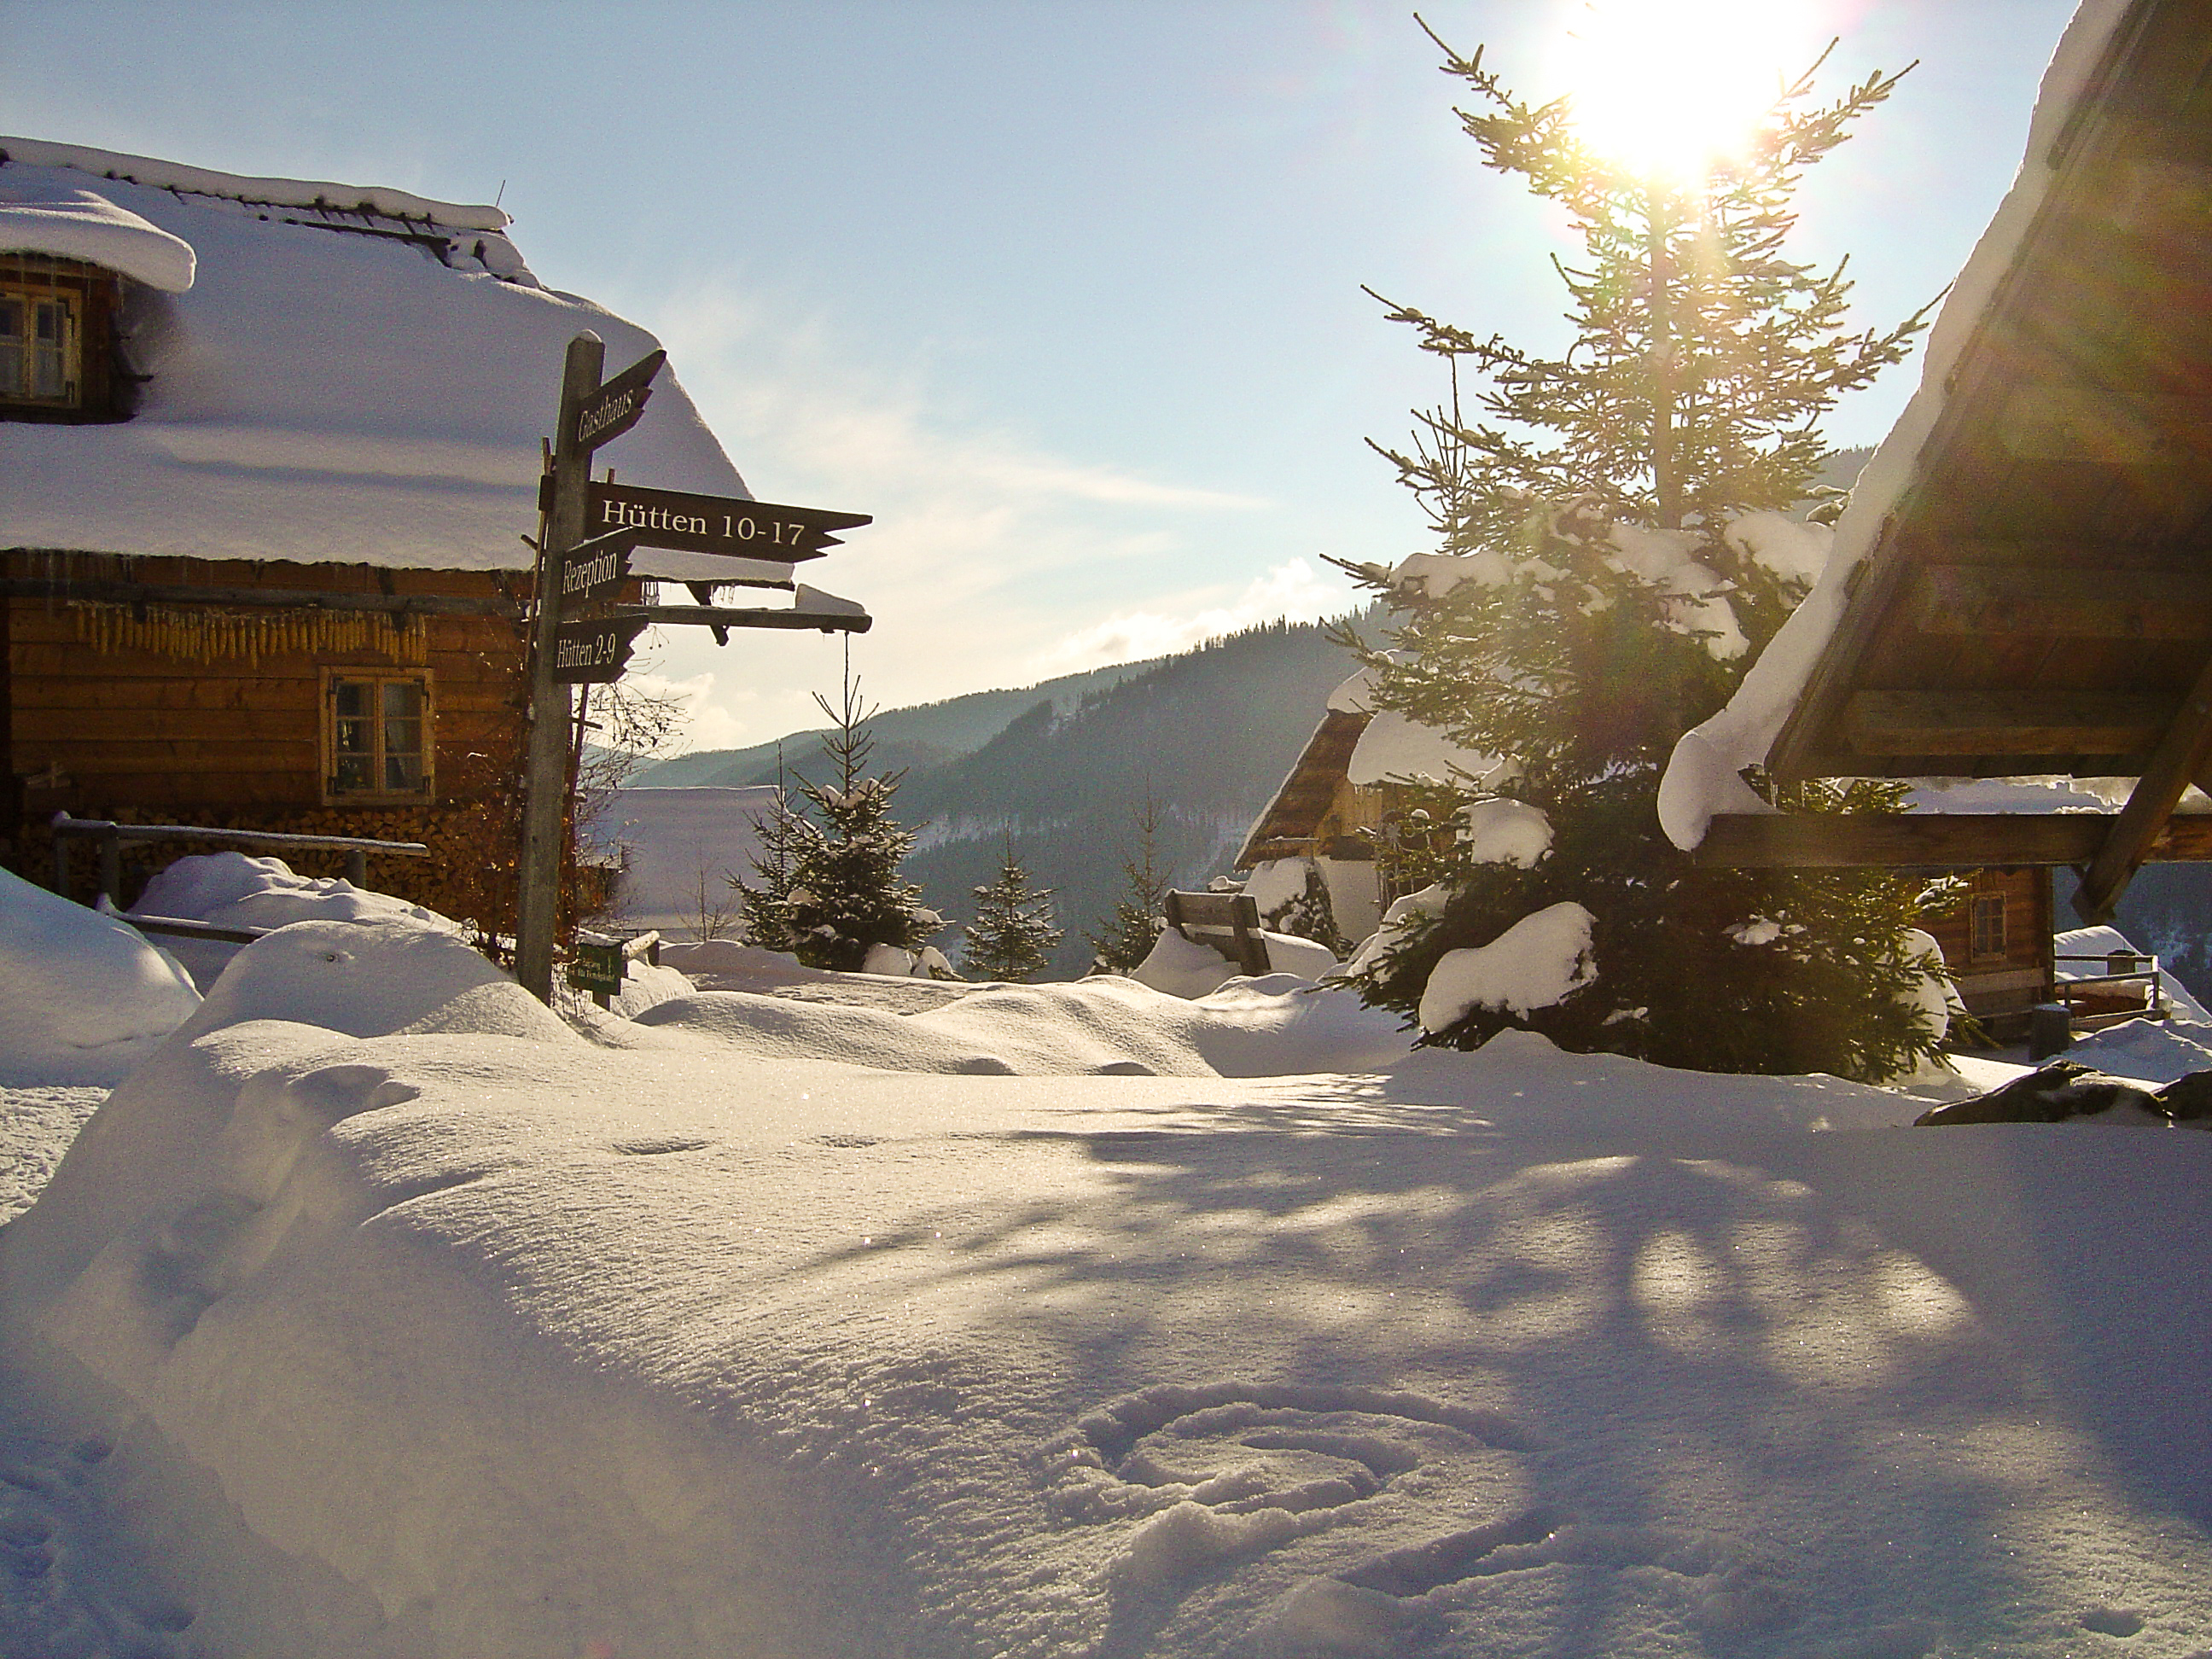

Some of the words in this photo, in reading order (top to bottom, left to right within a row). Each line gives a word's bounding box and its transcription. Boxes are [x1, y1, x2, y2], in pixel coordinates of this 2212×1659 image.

[579, 389, 633, 442] Gasthaus
[602, 499, 707, 535] Hütten
[723, 515, 805, 545] 10-17
[563, 550, 617, 598] Rezeption
[557, 638, 592, 667] Hütten
[595, 633, 616, 664] 2-9
